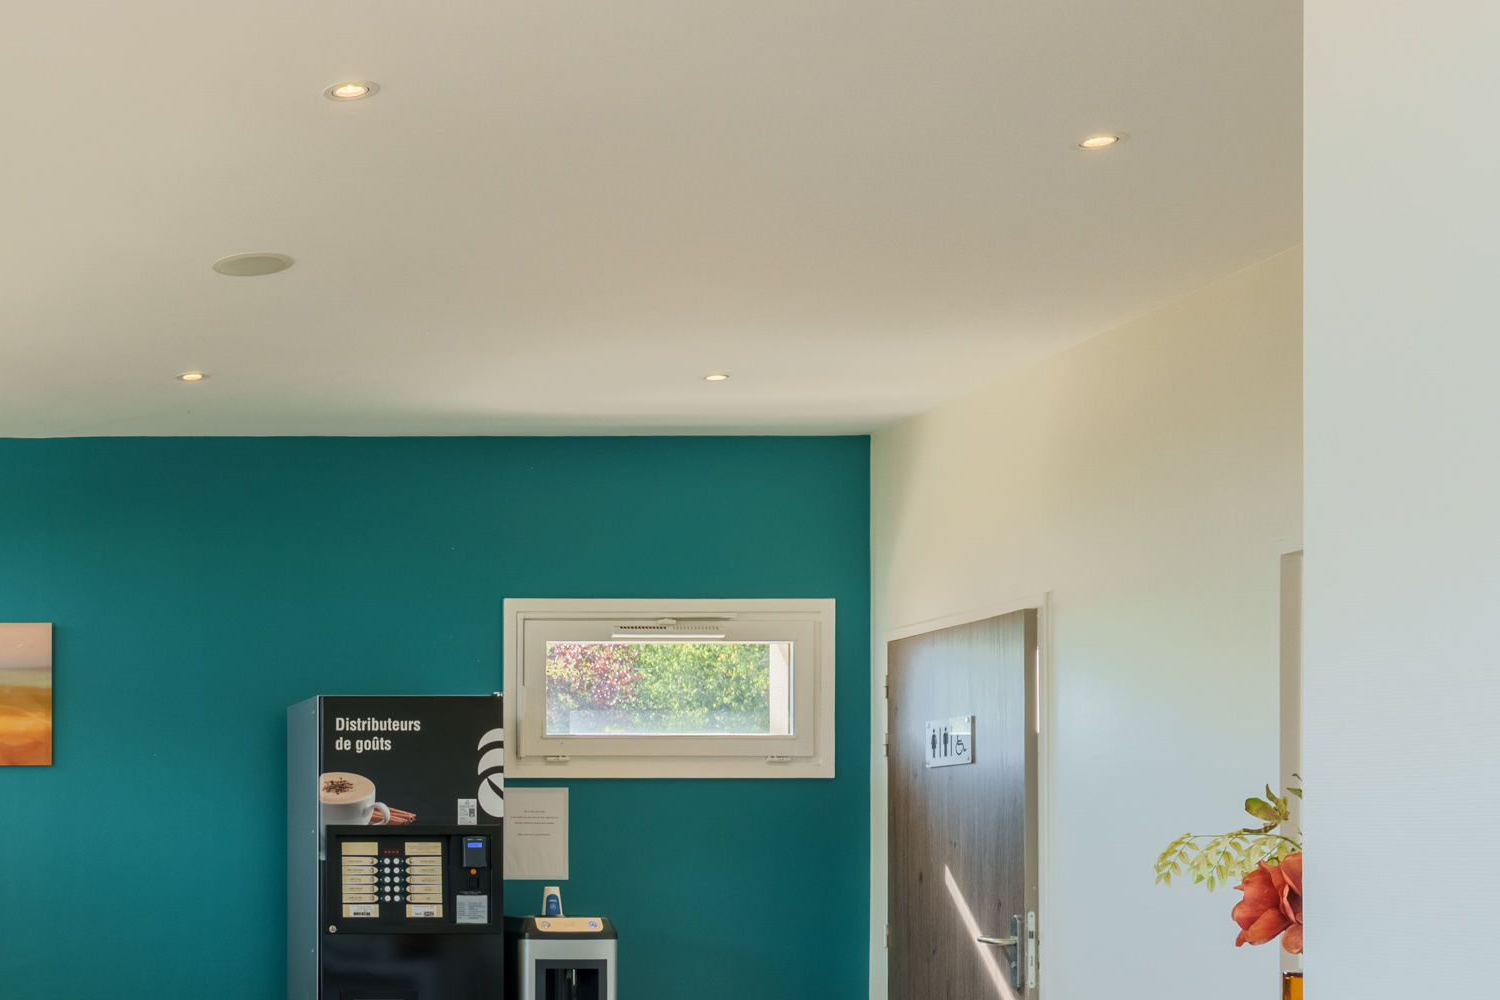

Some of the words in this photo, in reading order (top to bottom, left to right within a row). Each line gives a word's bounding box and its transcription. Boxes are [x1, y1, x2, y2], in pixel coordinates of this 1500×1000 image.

[335, 717, 421, 732] Distributeurs
[335, 736, 352, 751] de
[355, 736, 392, 754] goûts
